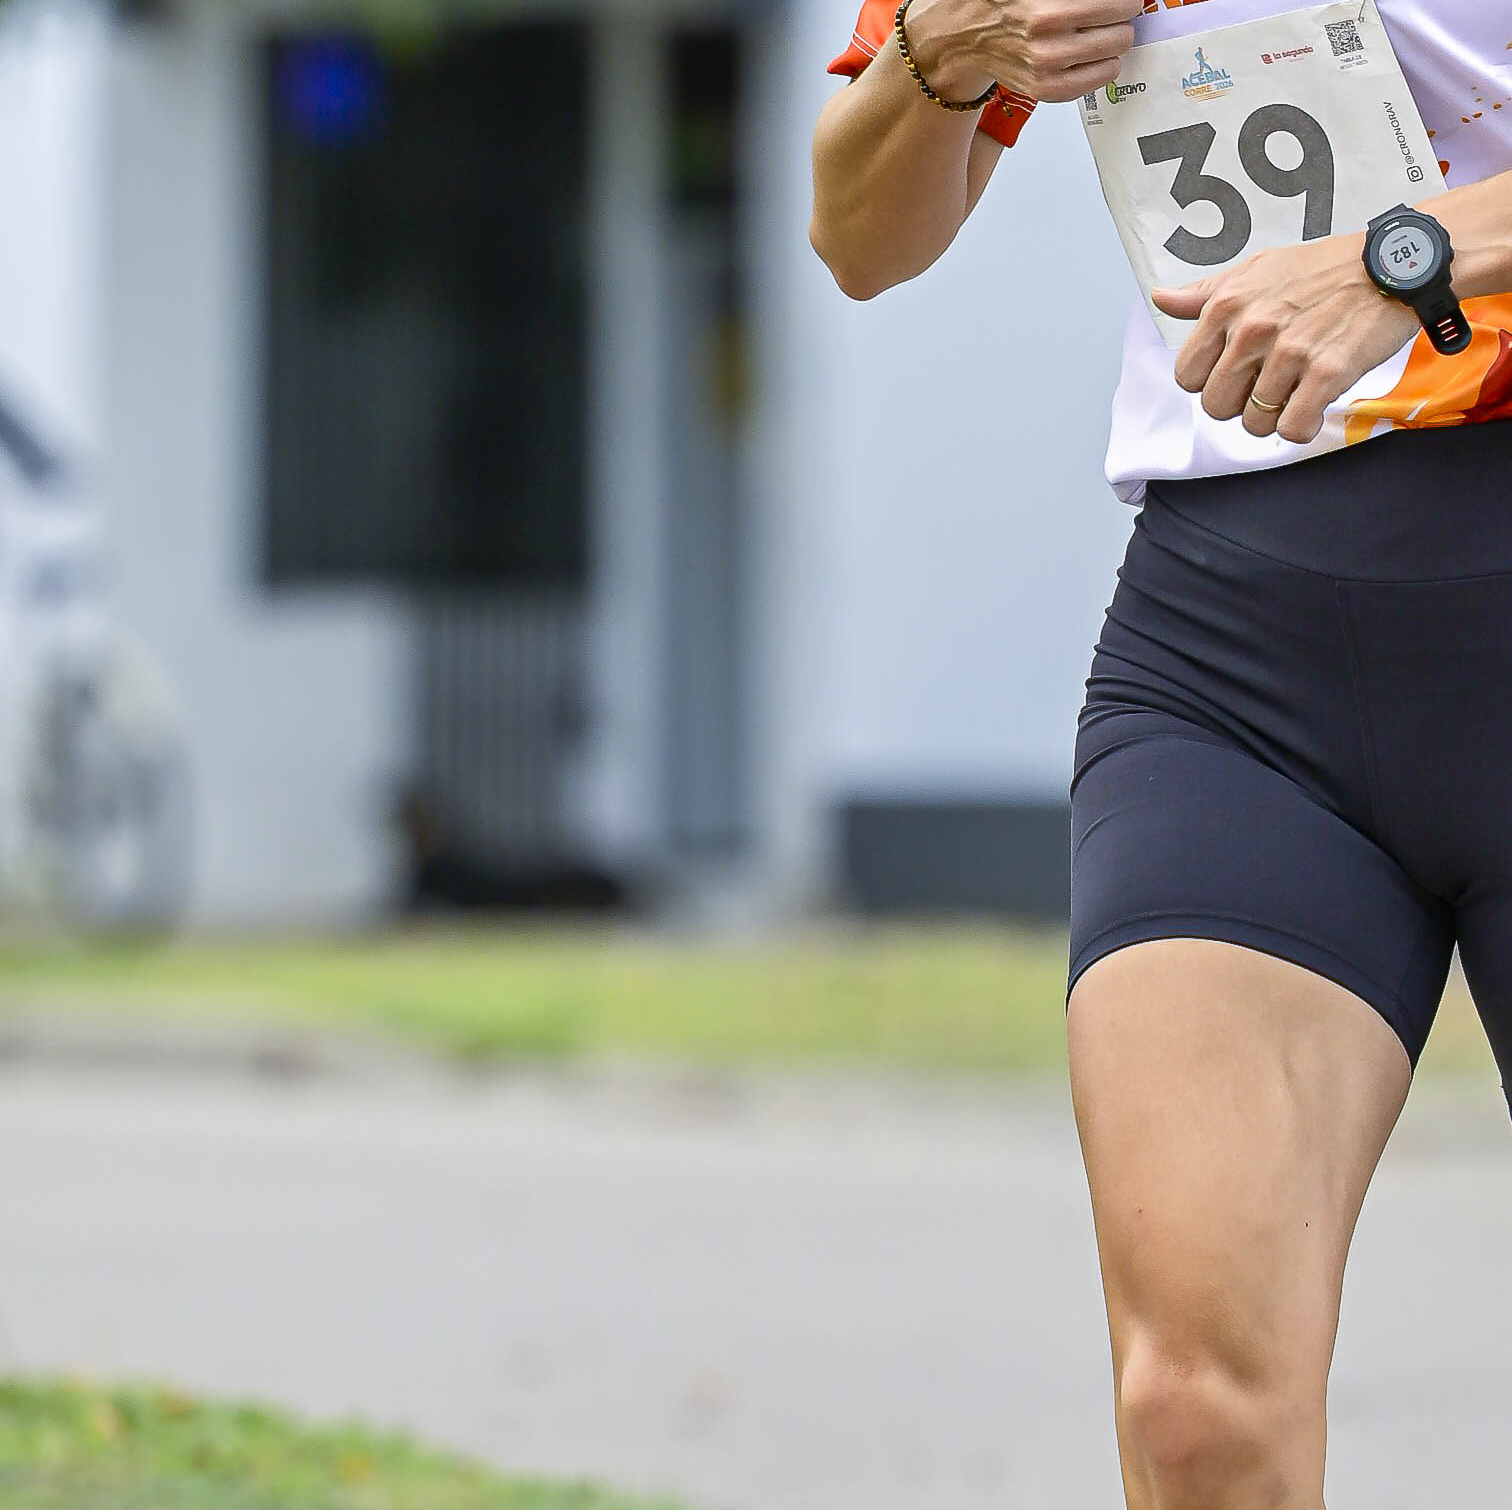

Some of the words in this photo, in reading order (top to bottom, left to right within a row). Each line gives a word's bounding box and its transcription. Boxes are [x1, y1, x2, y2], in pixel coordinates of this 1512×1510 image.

[1182, 68, 1231, 89] ACEBAL
[1184, 84, 1213, 97] CORRE
[1383, 101, 1415, 165] @CRONORAV
[1136, 103, 1336, 266] 39
[1390, 241, 1421, 264] 182
